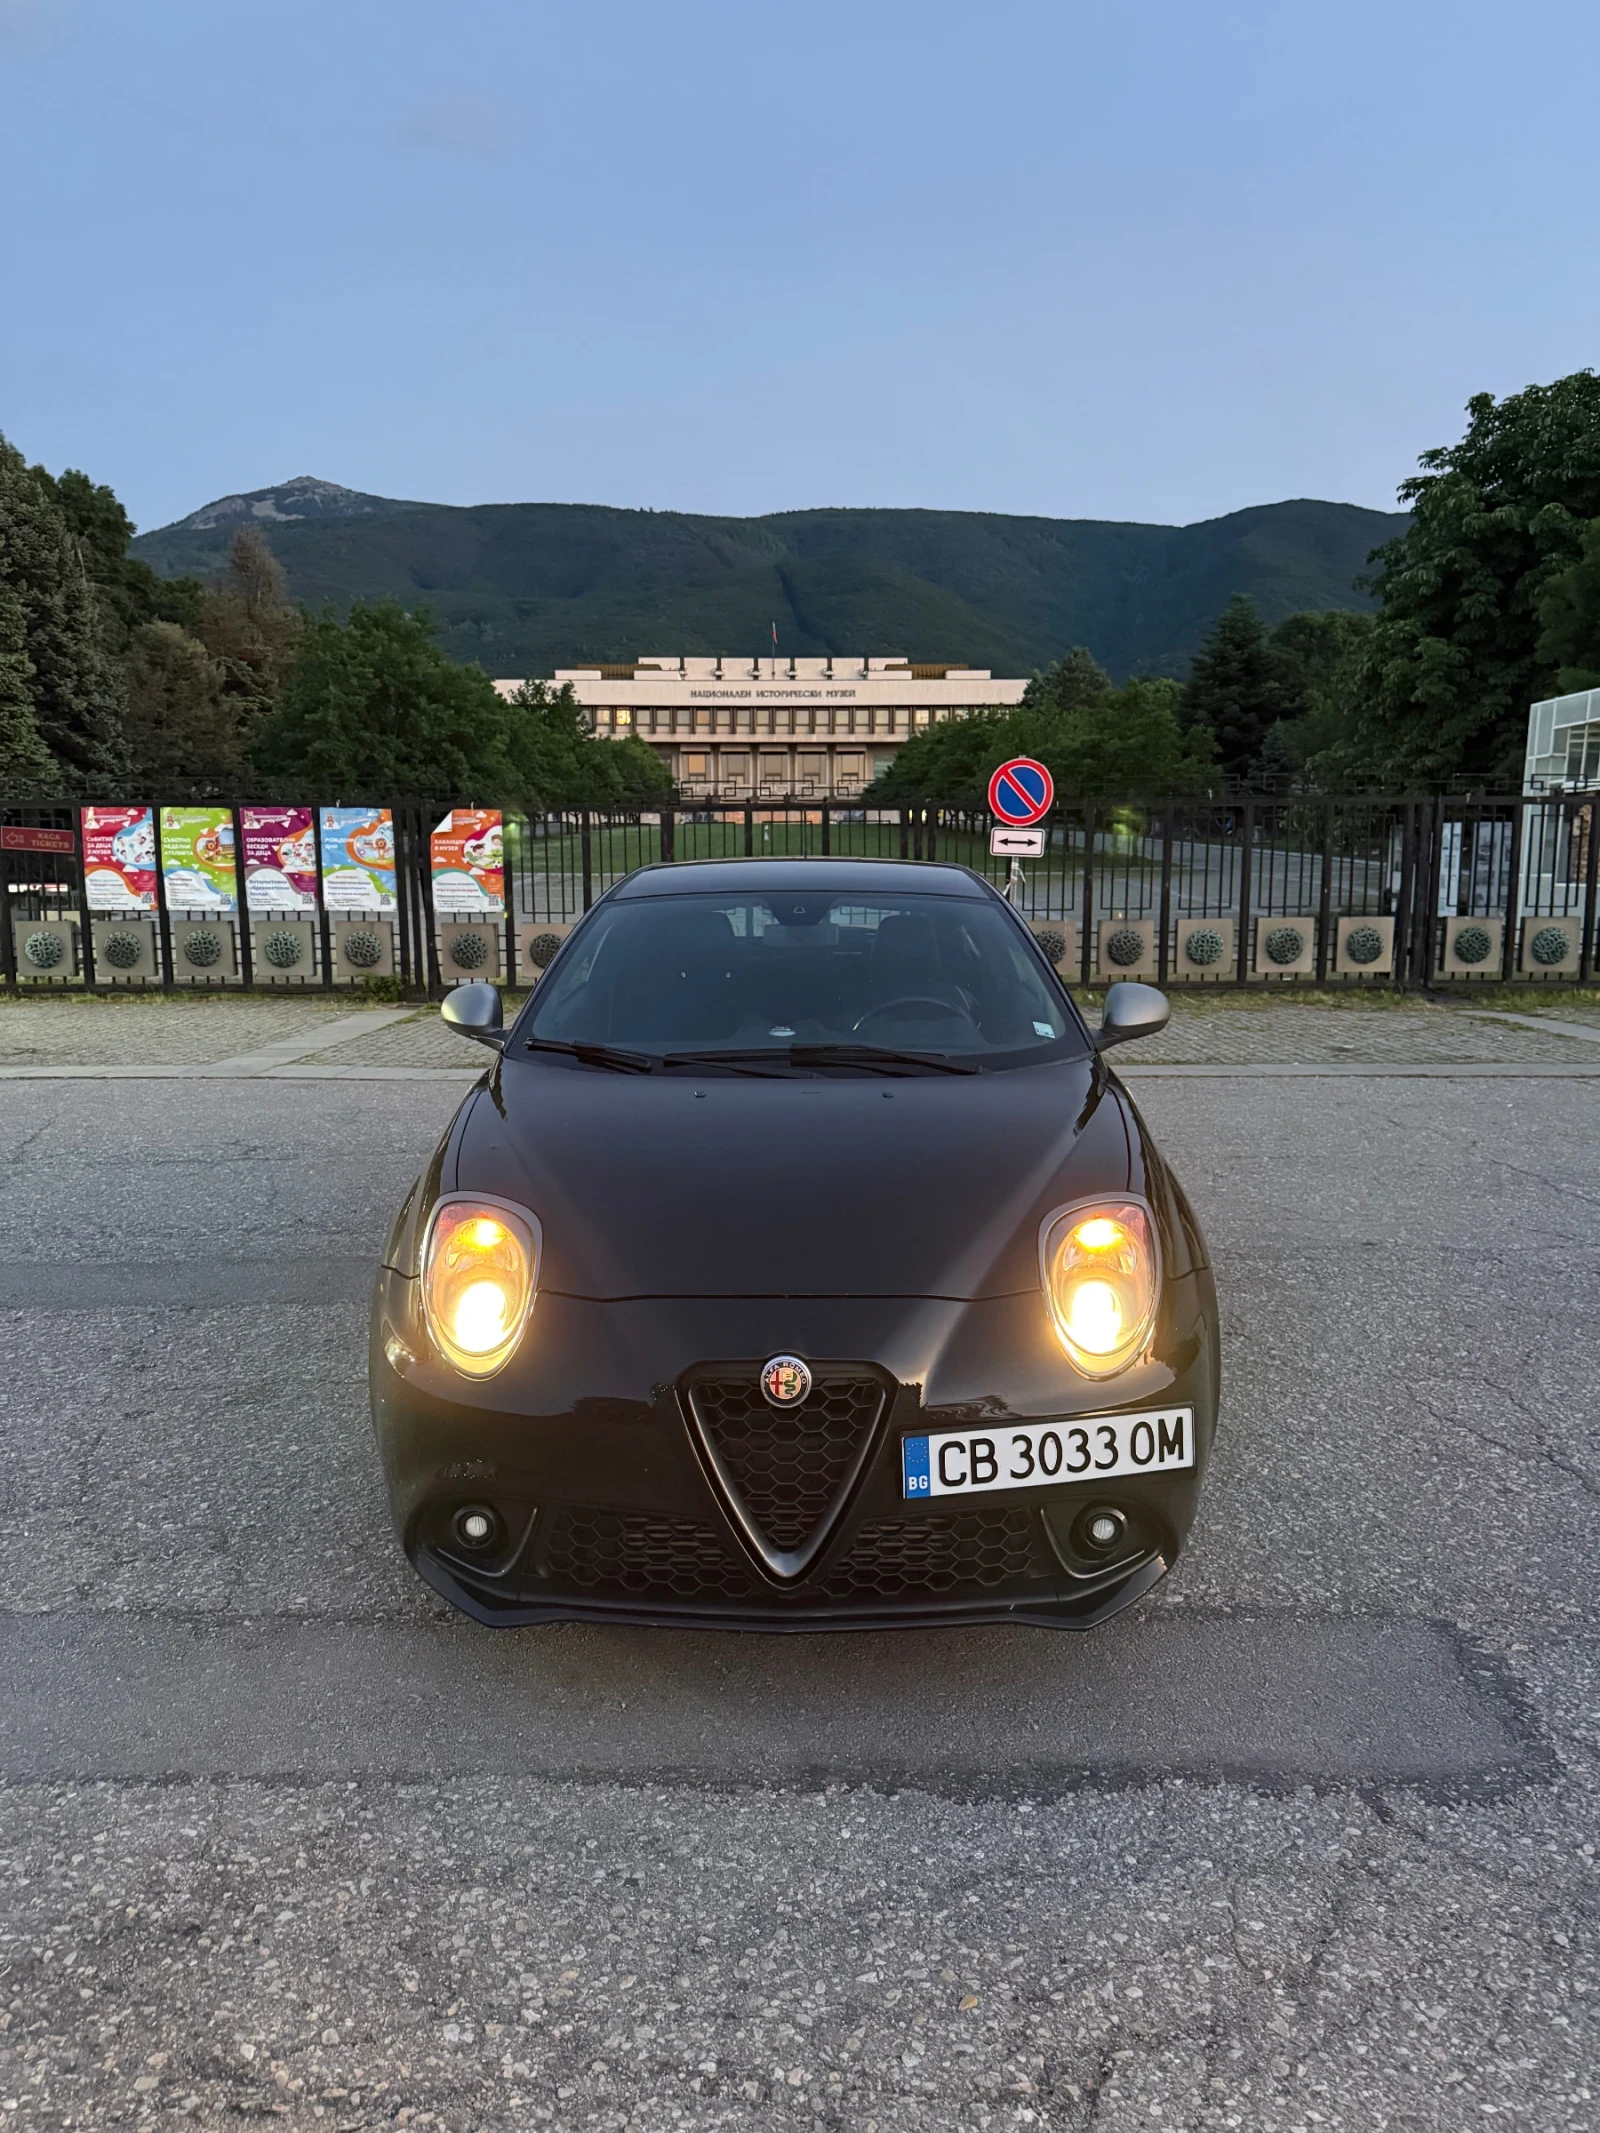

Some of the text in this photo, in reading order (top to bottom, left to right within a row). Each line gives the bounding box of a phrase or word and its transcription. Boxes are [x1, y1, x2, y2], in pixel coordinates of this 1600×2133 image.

[690, 689, 856, 698] НАЦИОНАЛЕН ИСТОРИЧЕСКИ МУЗЕЙ
[38, 832, 60, 840] КАСА
[31, 840, 70, 849] TICKETS
[765, 1361, 807, 1384] ALFA ROMEO
[938, 1416, 1184, 1487] CB 3033 OM
[908, 1475, 929, 1491] BG
